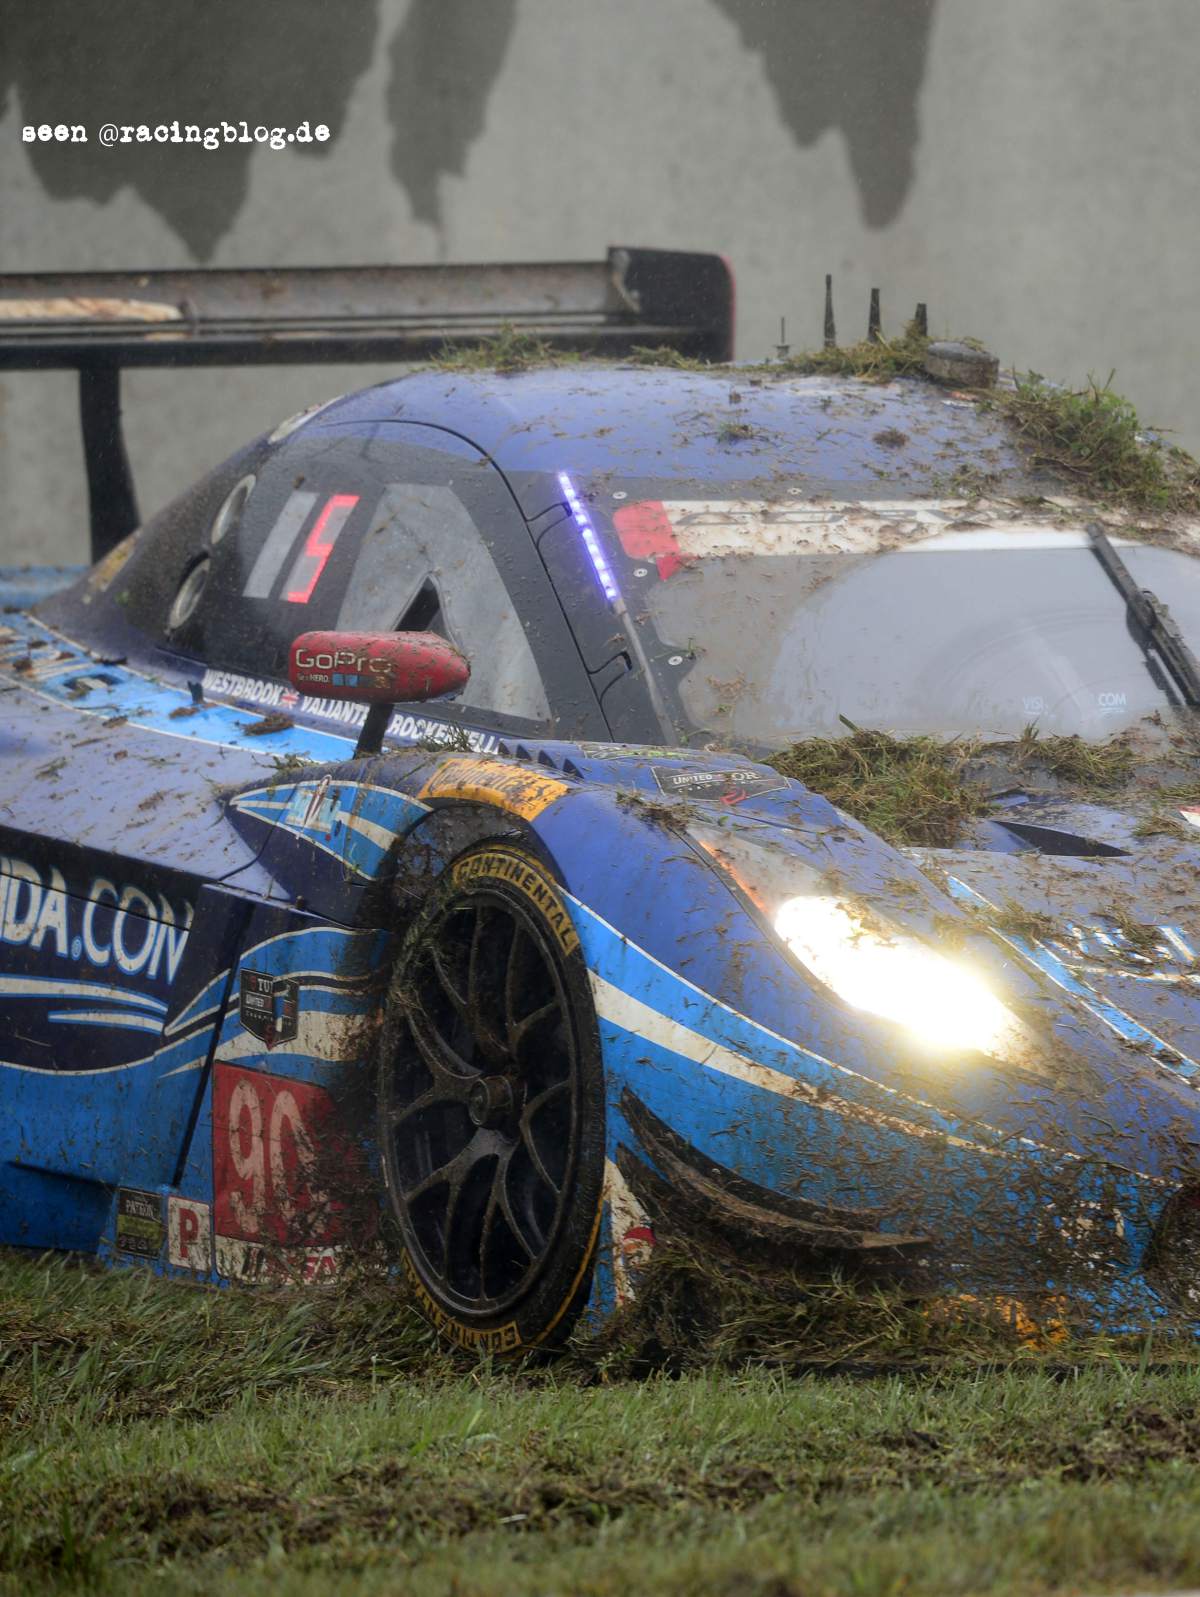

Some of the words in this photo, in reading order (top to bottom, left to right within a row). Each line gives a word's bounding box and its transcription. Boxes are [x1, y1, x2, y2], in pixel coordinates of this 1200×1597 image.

[295, 649, 391, 674] GoPro
[202, 669, 283, 706] WESTBROOK
[457, 854, 577, 947] CONTINENTAL
